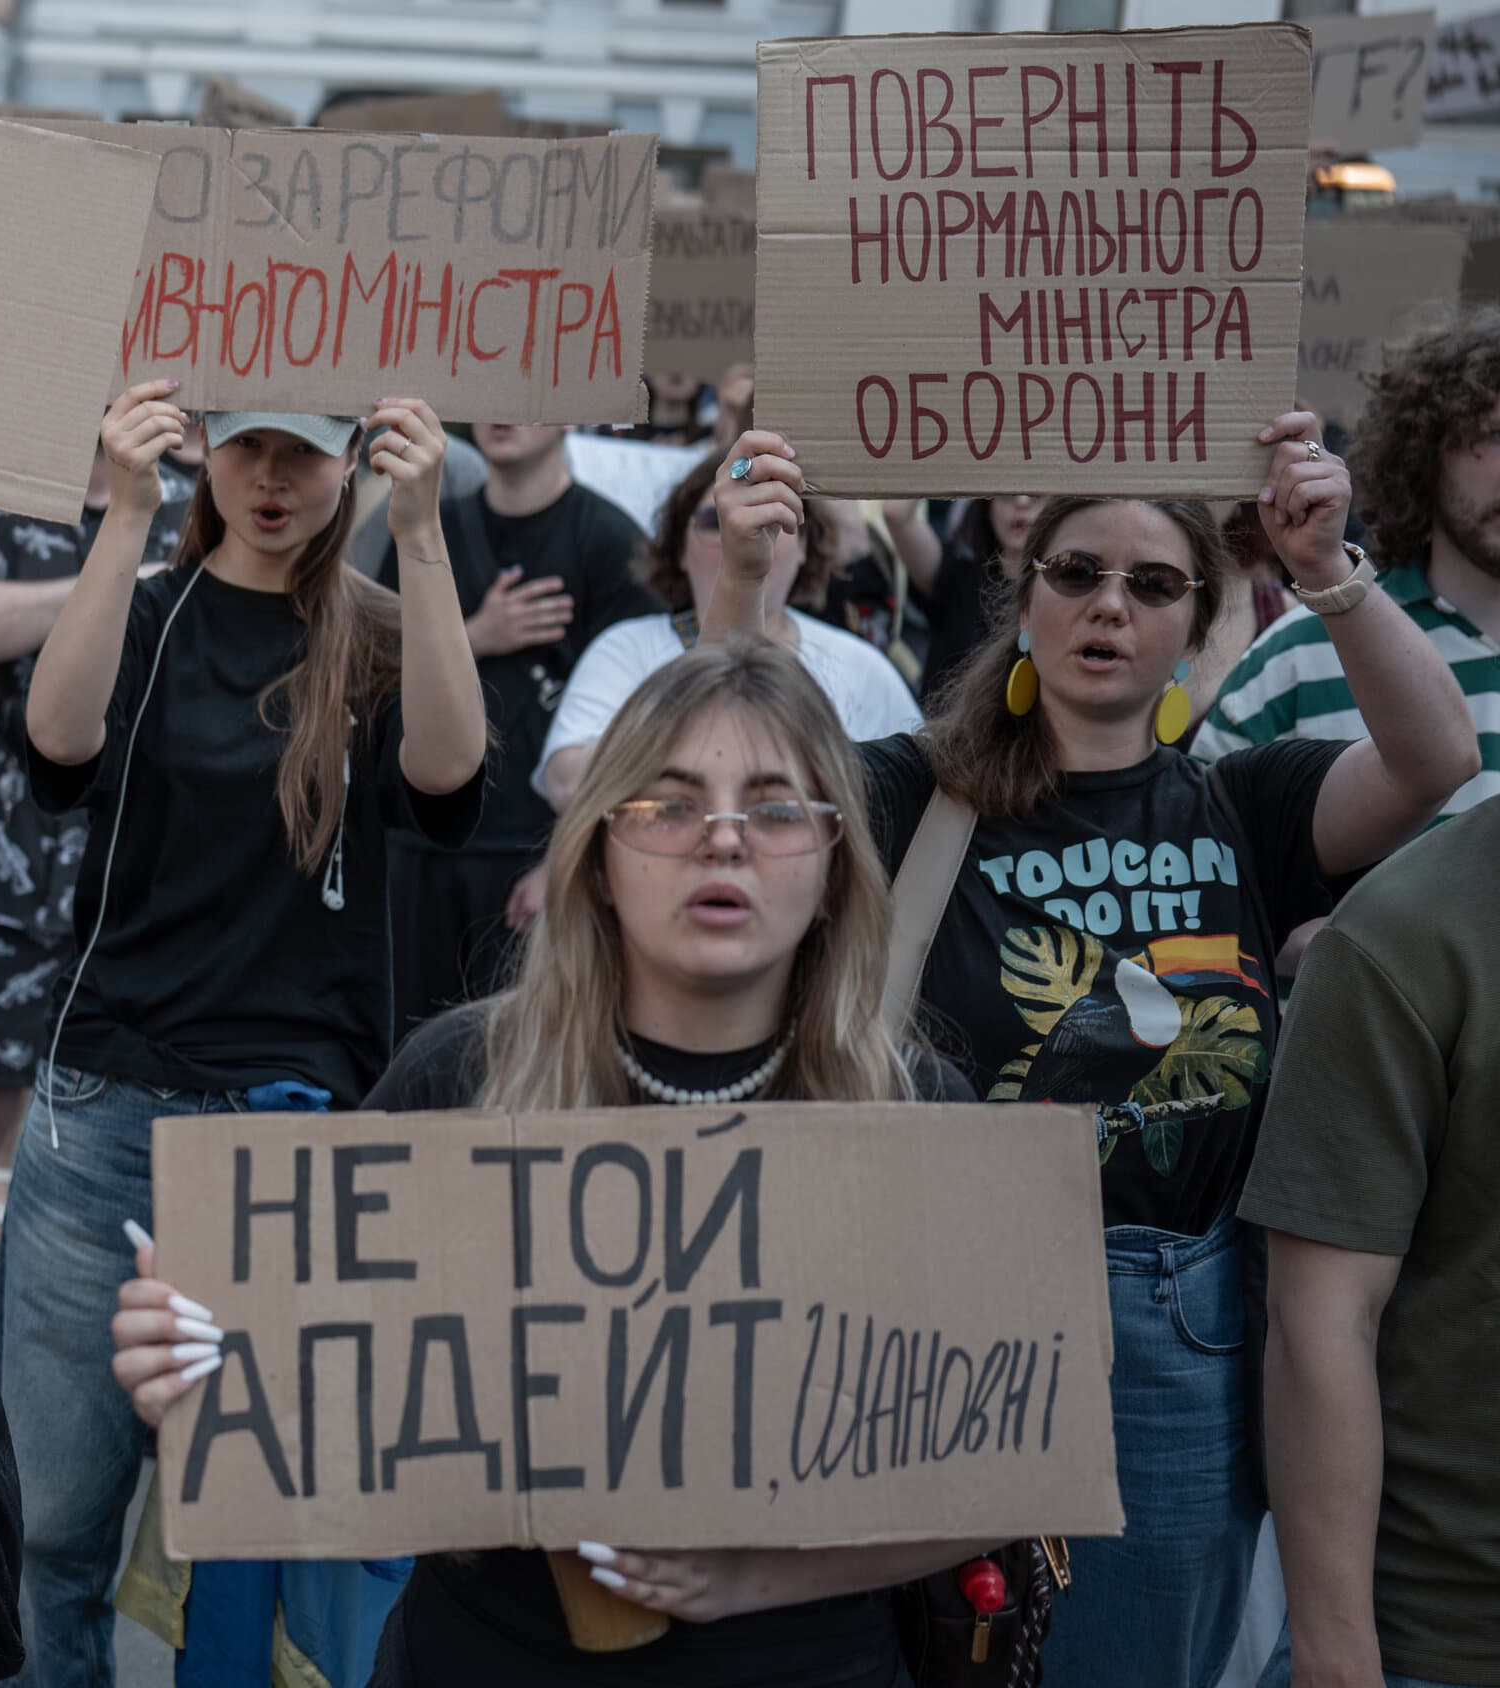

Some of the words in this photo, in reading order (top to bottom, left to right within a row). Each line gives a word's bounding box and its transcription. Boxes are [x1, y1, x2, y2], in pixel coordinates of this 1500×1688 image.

[806, 59, 1258, 181] ПОВЕРНІТЬ
[336, 143, 656, 250] РЕФОРМИ
[849, 187, 1264, 284] НОРМАЛЬНОГО
[979, 286, 1253, 365] МІНІСТРА
[856, 371, 1208, 463] ОБОРОНИ
[979, 837, 1238, 898] TOUCAN
[1043, 890, 1122, 936] DO
[1130, 889, 1202, 933] IT!
[232, 1143, 418, 1284] НЕ
[472, 1113, 763, 1292] ТОЙ
[180, 1278, 783, 1504] АПДЕЙТ,
